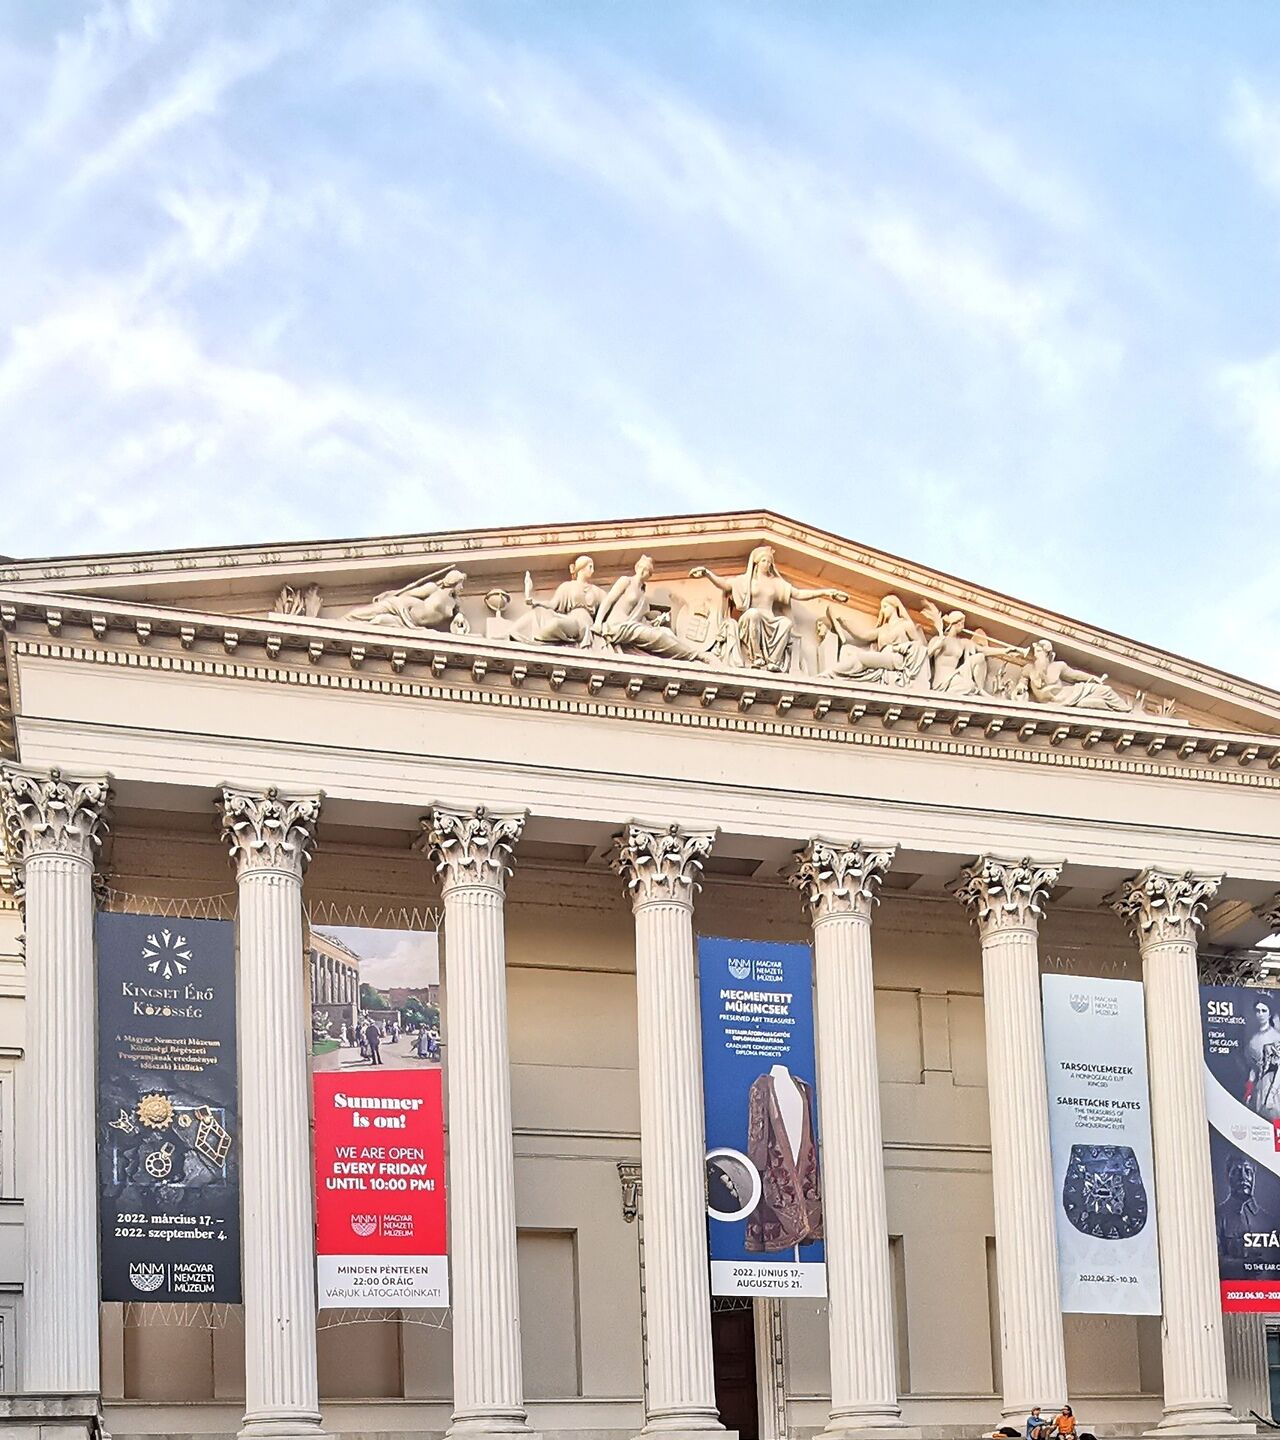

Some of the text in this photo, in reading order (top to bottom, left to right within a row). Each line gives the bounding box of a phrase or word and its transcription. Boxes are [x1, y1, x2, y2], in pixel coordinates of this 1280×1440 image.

[728, 958, 750, 967] MNM
[756, 960, 782, 968] MAGYAR
[720, 989, 793, 1003] MEGMENTETT
[725, 1000, 788, 1015] MŰKINCSEK
[1207, 1001, 1233, 1016] SISI
[719, 1014, 750, 1022] PRESERVED
[124, 1035, 153, 1044] Magyar
[154, 1036, 186, 1044] Nemzeti
[1060, 1062, 1133, 1074] TARSOLYLEMEZEK
[334, 1093, 423, 1110] Summer
[1057, 1097, 1141, 1110] SABRETACHE PLATES
[352, 1111, 406, 1129] is on!
[336, 1147, 424, 1160] WE ARE OPEN
[334, 1162, 427, 1175] EVERY FRIDAY
[326, 1178, 435, 1191] UNTIL 10:00 PM!
[117, 1214, 148, 1223] 2022.
[151, 1214, 196, 1224] március
[200, 1216, 214, 1226] 17.
[350, 1214, 377, 1223] MNM
[115, 1228, 227, 1241] 2022. szeptember 4.
[129, 1262, 164, 1274] MNM
[174, 1264, 214, 1272] MAGYAR
[338, 1264, 428, 1274] MINDEN PÉNTEKEN
[733, 1269, 756, 1277] 2022.
[758, 1268, 788, 1278] JÚNIUS
[174, 1274, 214, 1282] NEMZETI
[382, 1276, 414, 1285] ÓRÁIG
[174, 1282, 214, 1293] MÚZEUM
[737, 1280, 789, 1288] AUGUSZTUS
[325, 1287, 360, 1298] VÁRJUK
